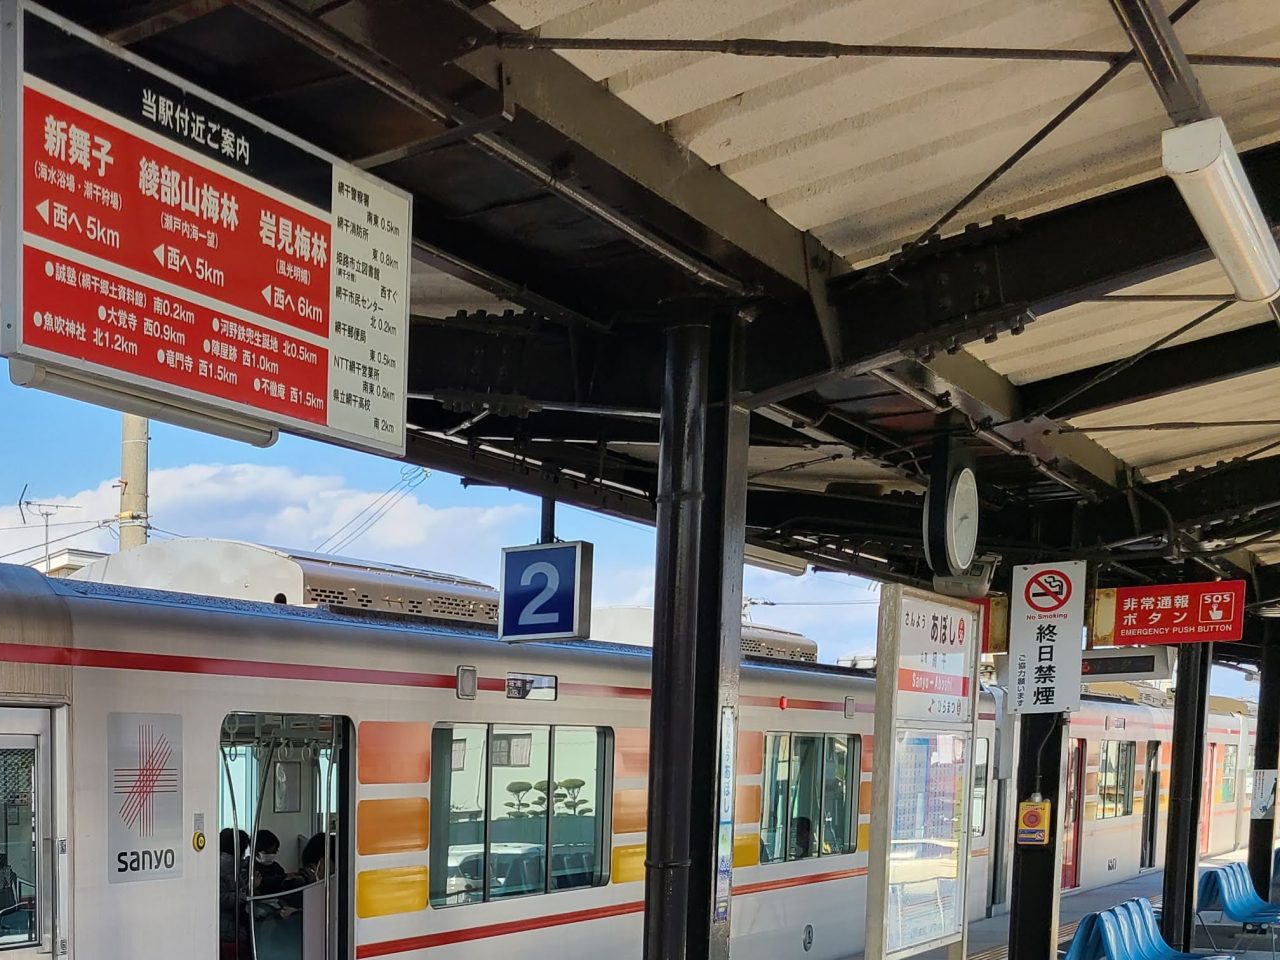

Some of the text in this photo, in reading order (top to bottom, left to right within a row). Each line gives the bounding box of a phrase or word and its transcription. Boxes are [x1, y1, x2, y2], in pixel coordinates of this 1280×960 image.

[142, 89, 250, 165] 当駅付近ご案内
[43, 114, 114, 177] 新舞子
[139, 157, 239, 231] 綾部山梅林
[259, 210, 327, 268] 岩見梅林
[43, 312, 87, 341] 魚吹神社
[107, 307, 138, 332] 大覚寺
[166, 350, 193, 373] 竜門寺
[518, 561, 560, 626] 2
[1123, 595, 1189, 611] 非常通報
[1204, 594, 1231, 604] SOS
[930, 613, 956, 645] あぼし
[1037, 612, 1068, 620] Smoking
[1123, 612, 1187, 626] ボタン
[1121, 624, 1233, 637] EMERGENCY PUSH BUTTON
[1033, 624, 1058, 705] 終日禁煙
[117, 848, 175, 873] sanyo
